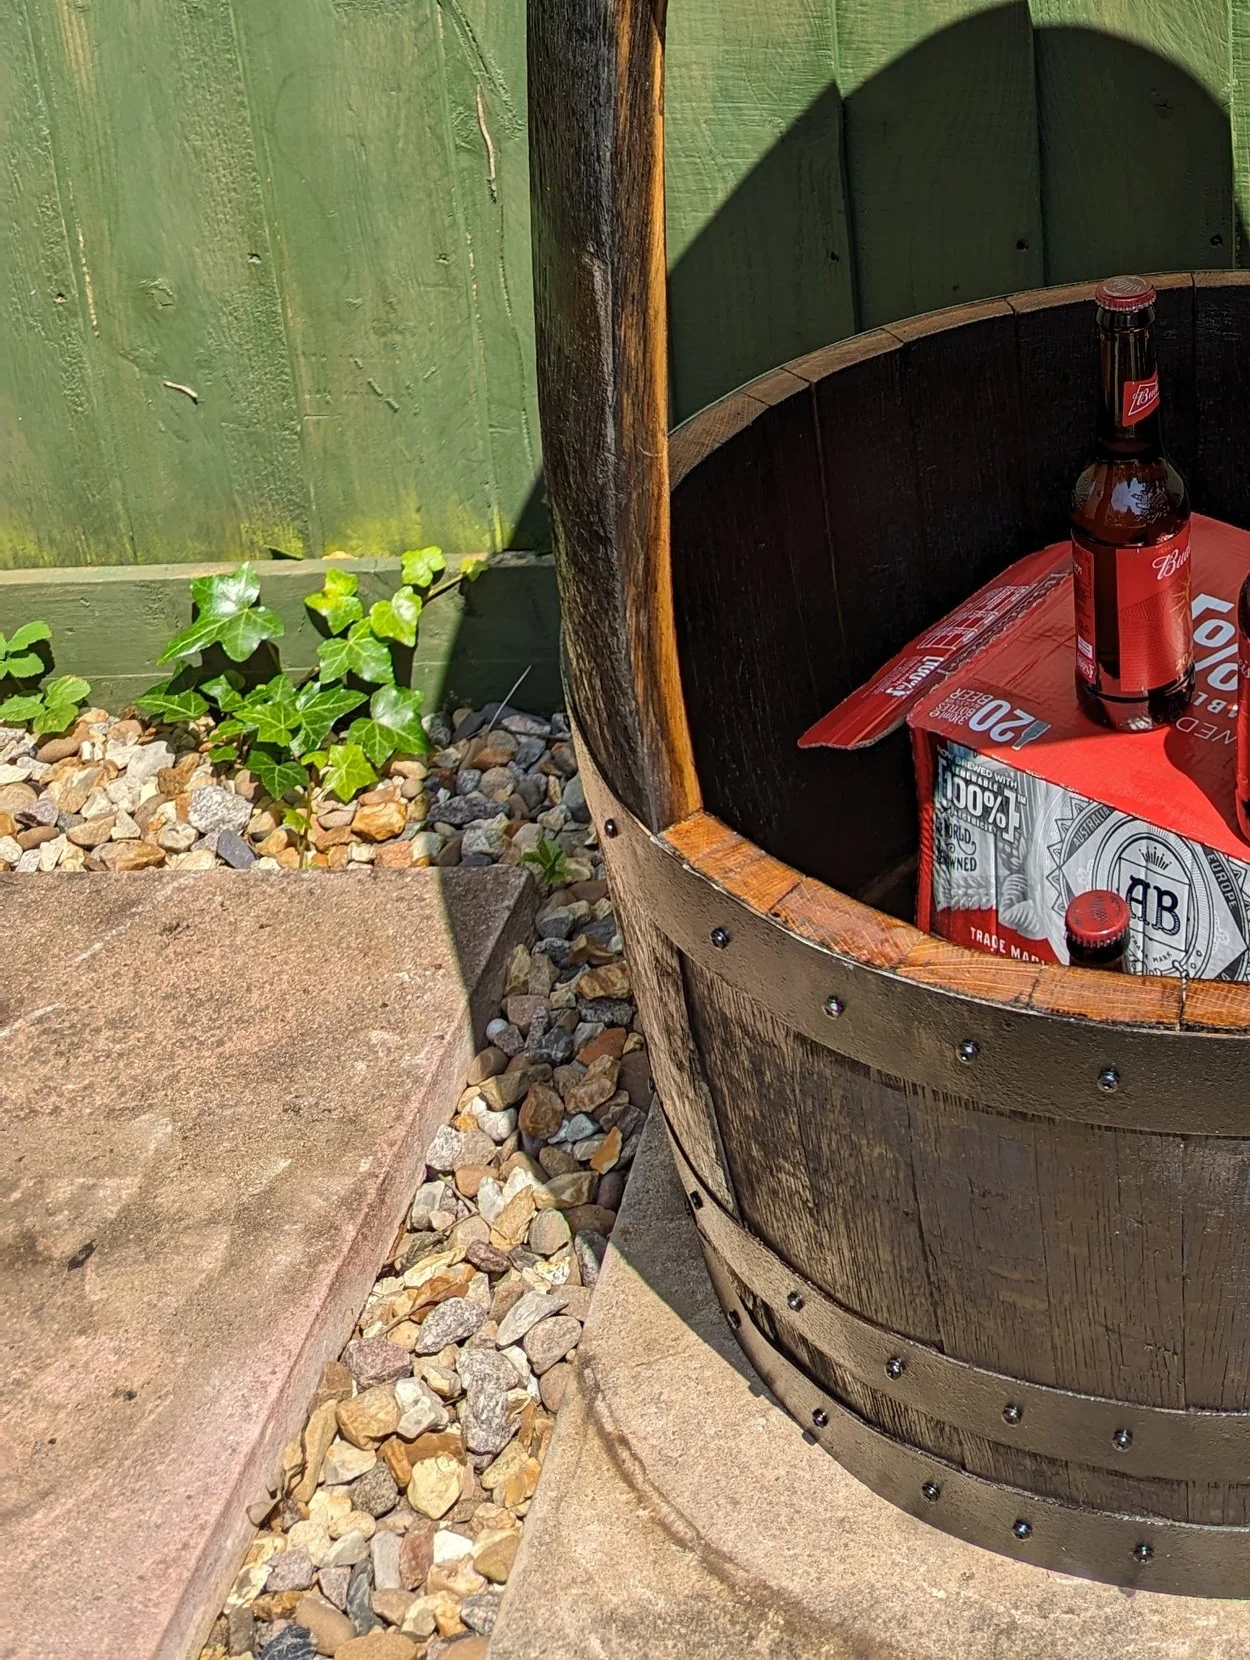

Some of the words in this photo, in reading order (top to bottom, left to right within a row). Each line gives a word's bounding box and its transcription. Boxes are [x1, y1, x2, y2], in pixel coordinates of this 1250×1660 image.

[937, 702, 977, 718] BOTTLES
[948, 687, 994, 705] BEER
[968, 698, 1036, 743] 20
[955, 756, 993, 778] BREWED
[994, 772, 1018, 790] WITH
[944, 770, 1007, 828] 100%
[1071, 805, 1111, 848] AUSTRALIA
[1207, 853, 1238, 909] EUROPE
[1125, 874, 1181, 936] AB
[970, 926, 1006, 954] TRADE
[1152, 950, 1173, 964] MARK
